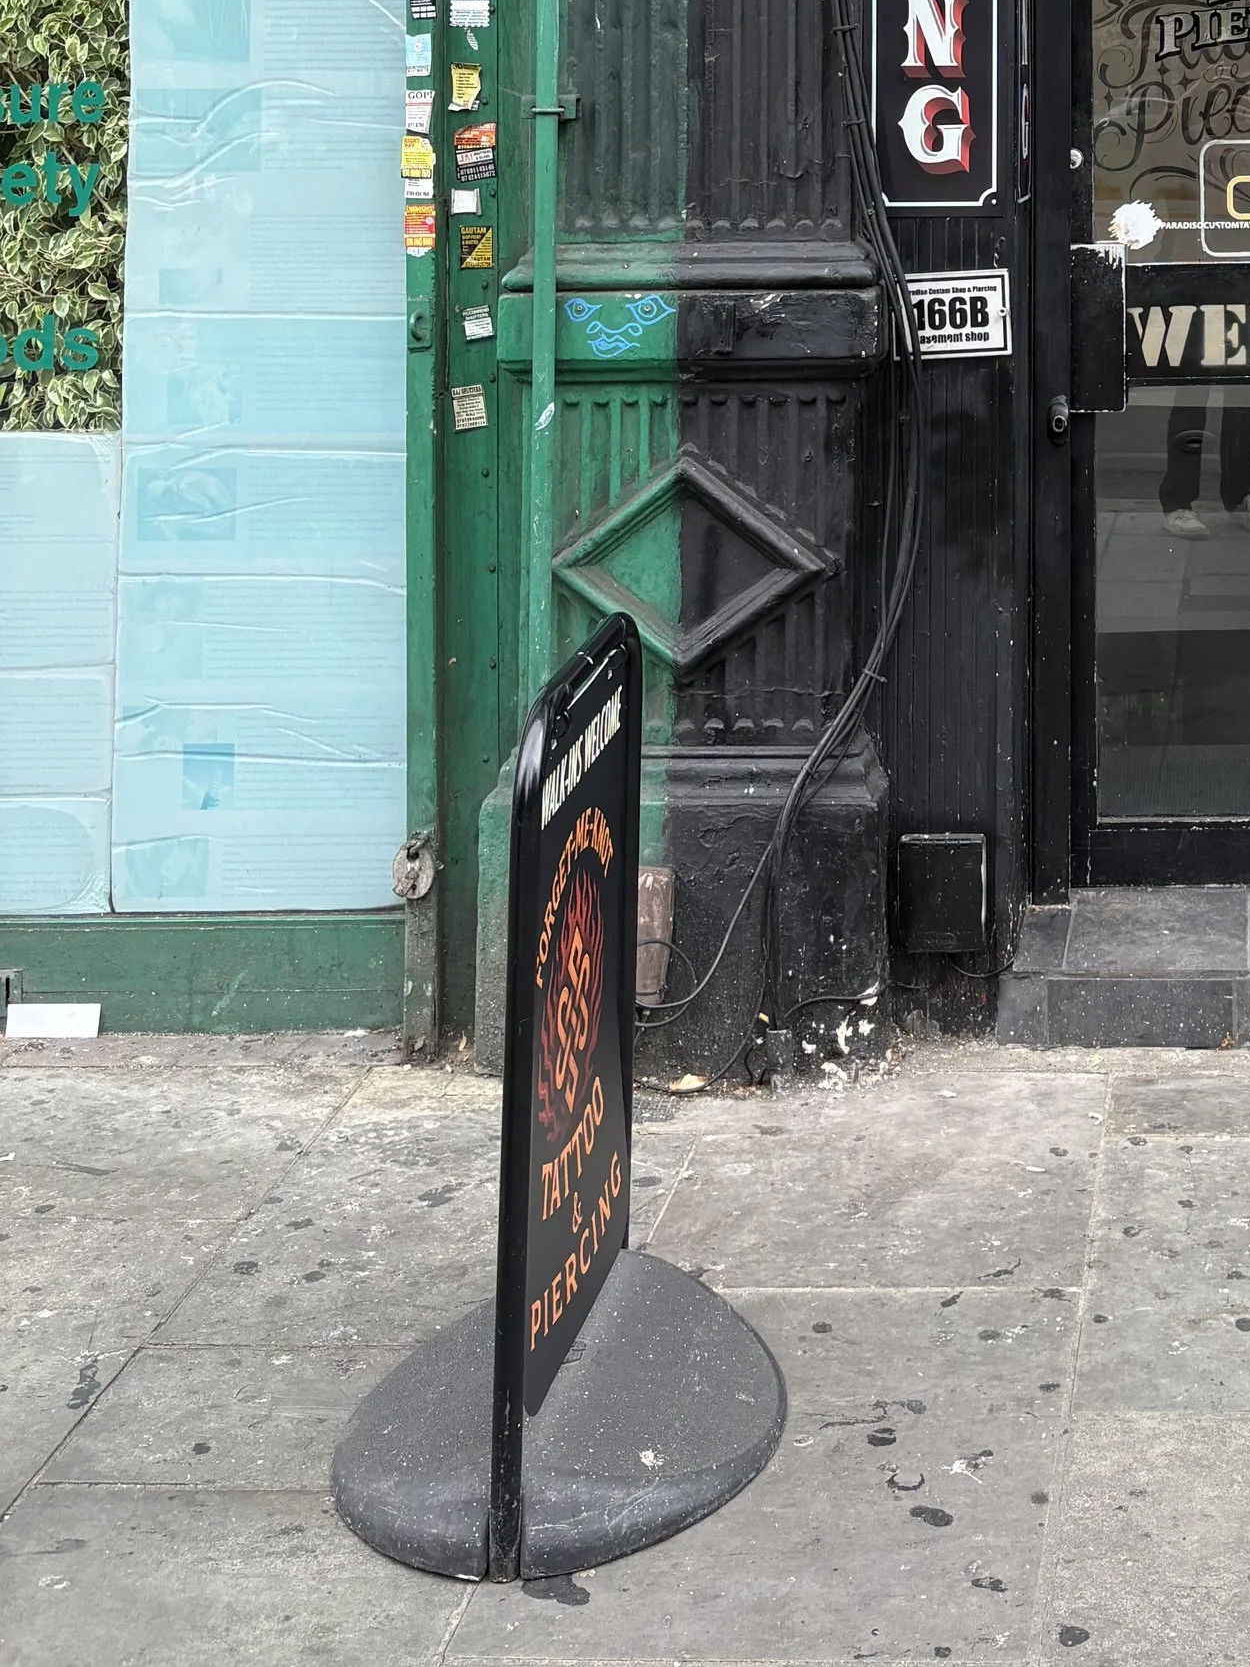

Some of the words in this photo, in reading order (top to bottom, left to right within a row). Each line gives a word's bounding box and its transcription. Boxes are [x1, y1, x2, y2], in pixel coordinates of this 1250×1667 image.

[912, 295, 990, 331] 166B
[929, 287, 951, 295] Custom
[952, 286, 966, 294] Shop
[972, 285, 997, 293] Piercing
[0, 313, 100, 372] ds
[920, 332, 963, 344] asement
[965, 331, 990, 342] shop
[541, 734, 583, 831] WALK-INS
[584, 684, 623, 773] WELCOME
[541, 1075, 604, 1222] TATTOO
[571, 1191, 583, 1234] &
[530, 1150, 623, 1353] PIERCING
